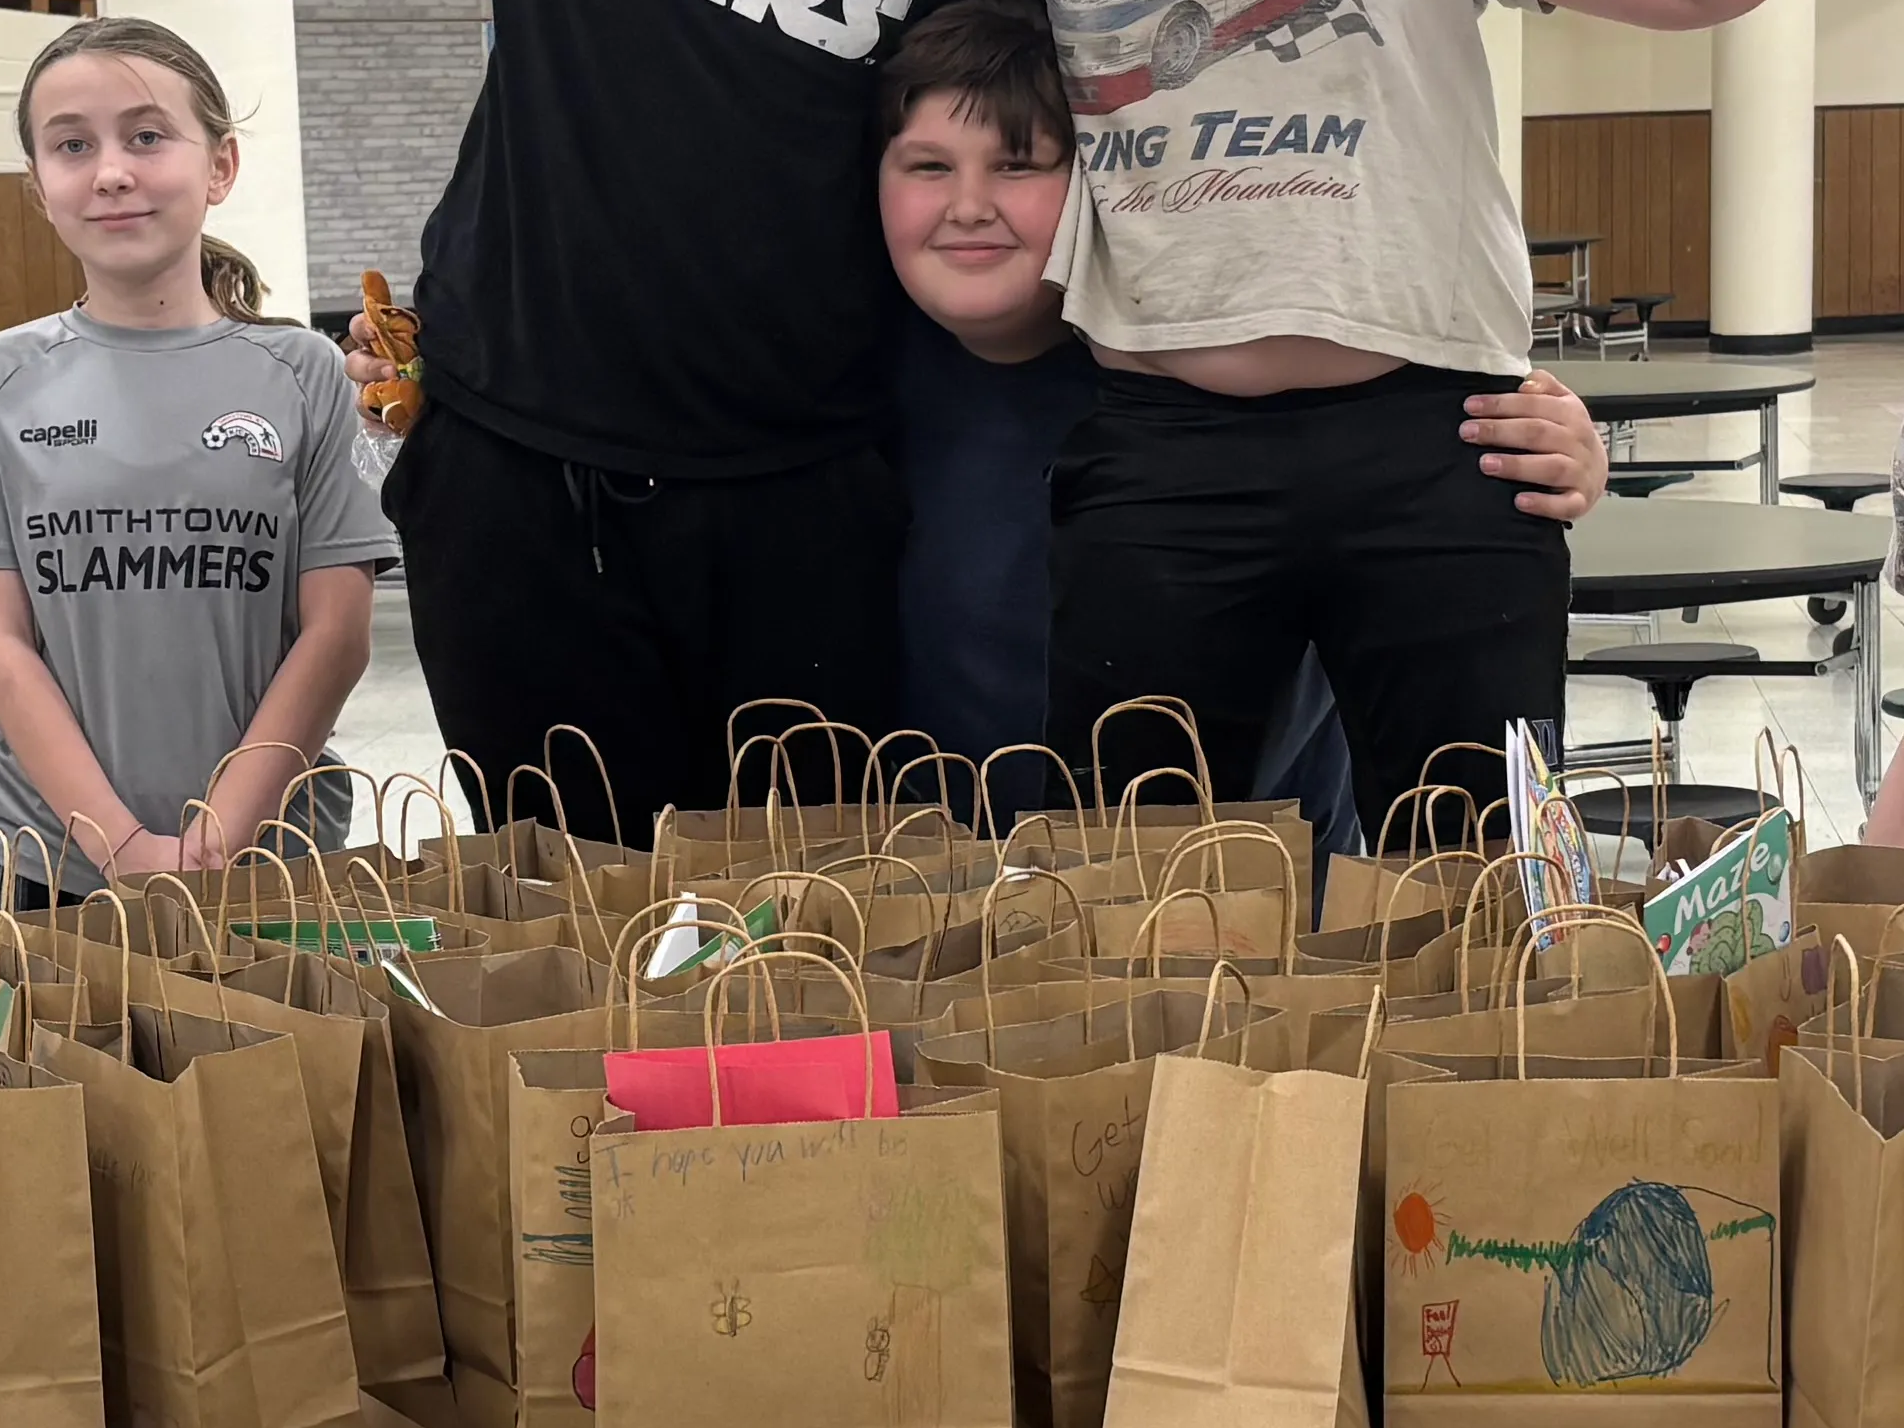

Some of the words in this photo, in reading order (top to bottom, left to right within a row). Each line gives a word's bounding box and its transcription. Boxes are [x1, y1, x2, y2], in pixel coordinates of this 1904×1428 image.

[1190, 109, 1367, 160] TEAM
[1110, 181, 1155, 214] the
[1161, 166, 1361, 214] Mountains
[19, 419, 97, 446] capelli
[26, 507, 279, 540] SMITHTOWN
[36, 544, 275, 595] SLAMMERS
[1673, 840, 1772, 936] Maze
[1071, 1094, 1145, 1177] Get
[736, 1139, 785, 1182] you
